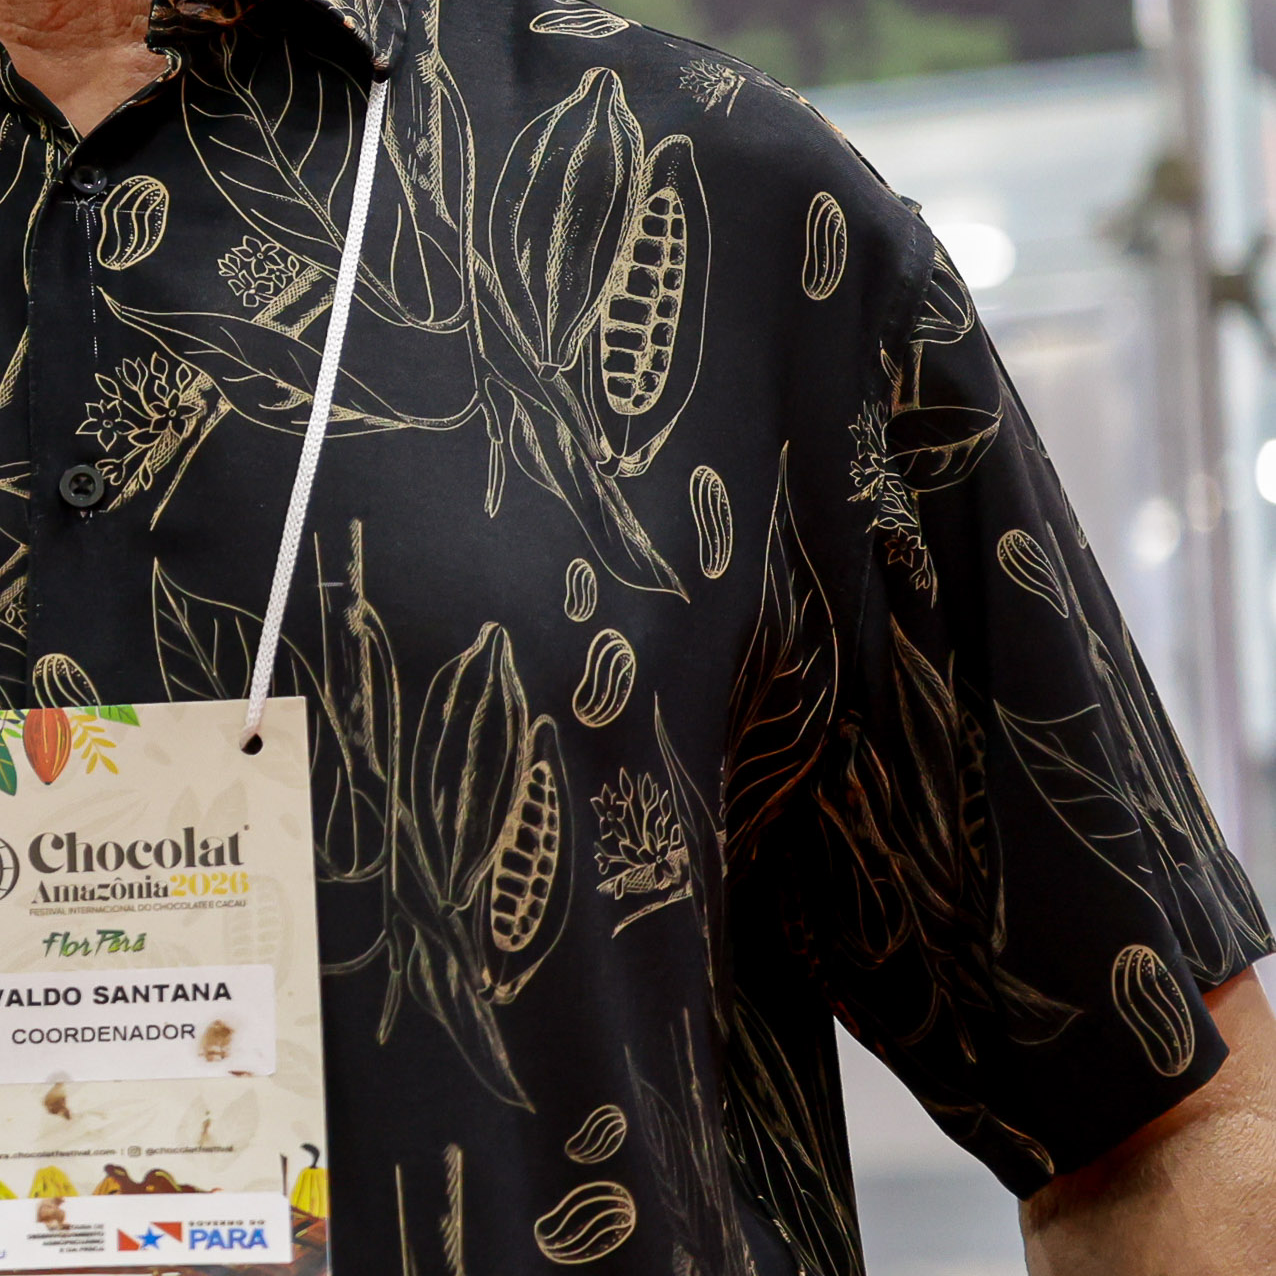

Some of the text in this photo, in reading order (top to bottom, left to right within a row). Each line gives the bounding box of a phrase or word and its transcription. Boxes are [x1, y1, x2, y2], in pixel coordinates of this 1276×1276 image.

[28, 827, 245, 874] Chocolat
[31, 876, 169, 904] Amazônia
[29, 907, 67, 917] FESTIVAL
[68, 904, 137, 915] INTERNACIONAL
[137, 903, 152, 912] DO
[153, 901, 208, 911] CHOCOLATE
[216, 899, 247, 909] CACAU
[93, 983, 232, 1004] SANTANA
[12, 1024, 196, 1044] COORDENADOR
